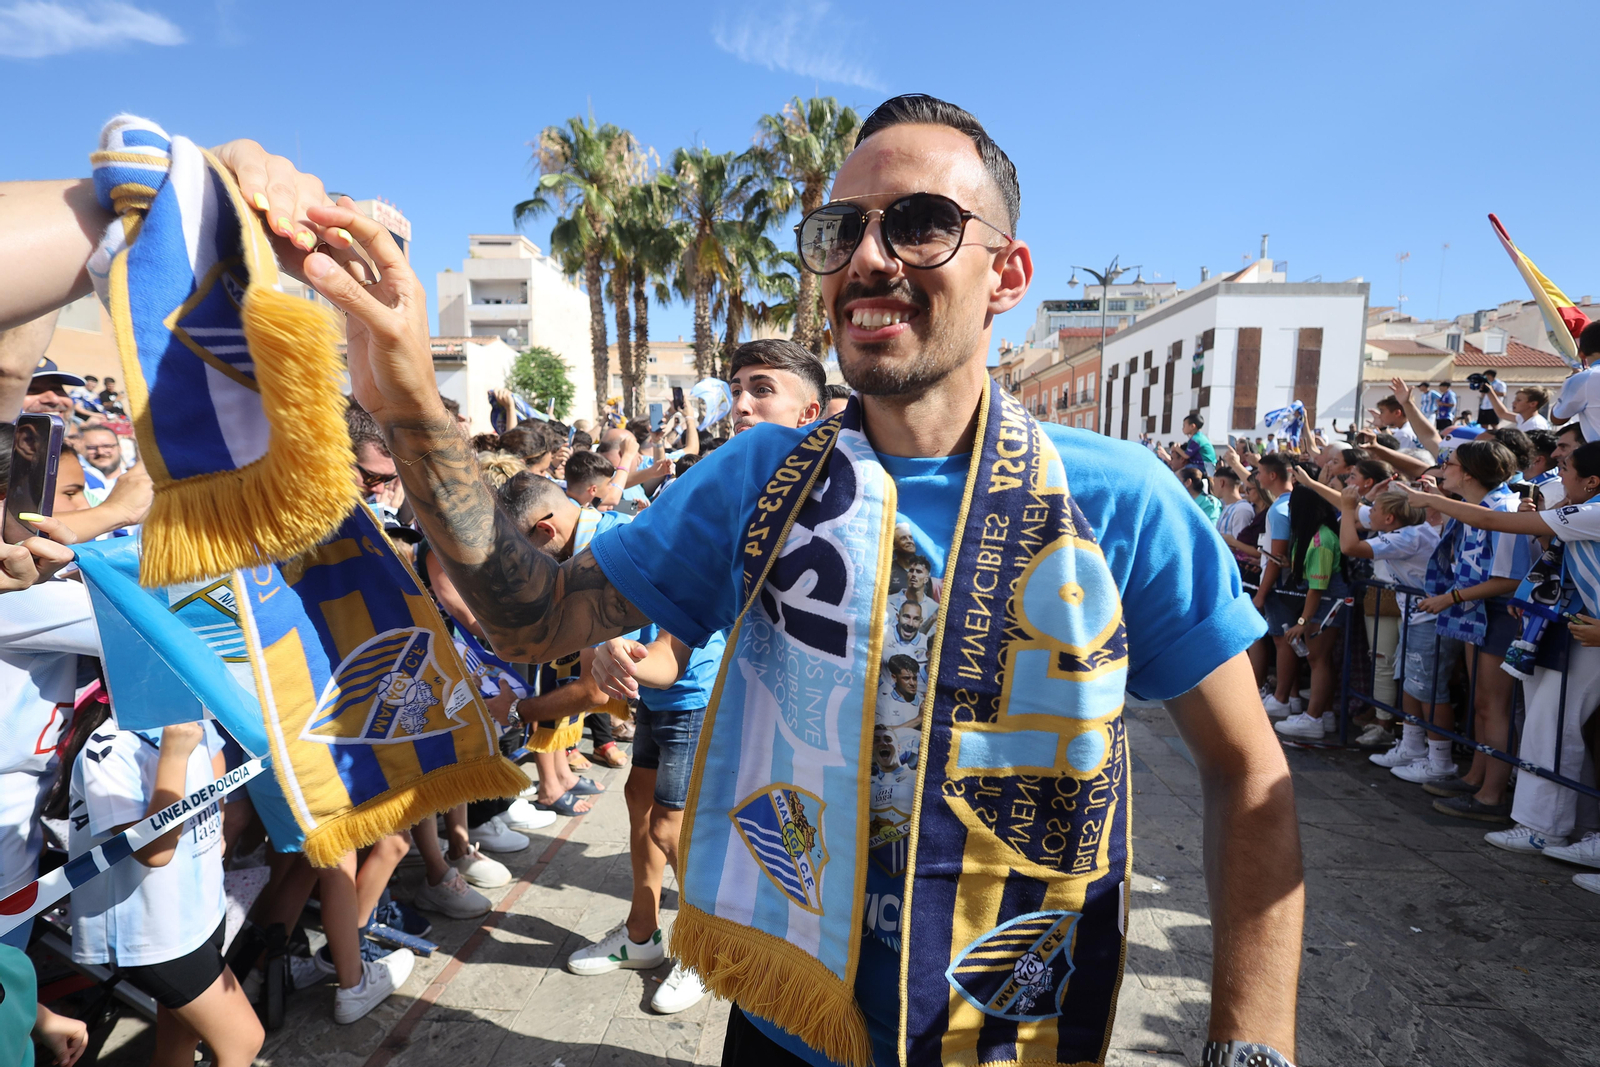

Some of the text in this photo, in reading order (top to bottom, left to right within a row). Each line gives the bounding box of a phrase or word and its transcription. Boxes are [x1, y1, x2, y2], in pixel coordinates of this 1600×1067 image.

[804, 687, 824, 746] INVE
[189, 787, 210, 808] DE
[207, 765, 251, 798] POLICIA
[774, 793, 815, 891] MALAGA C.F.
